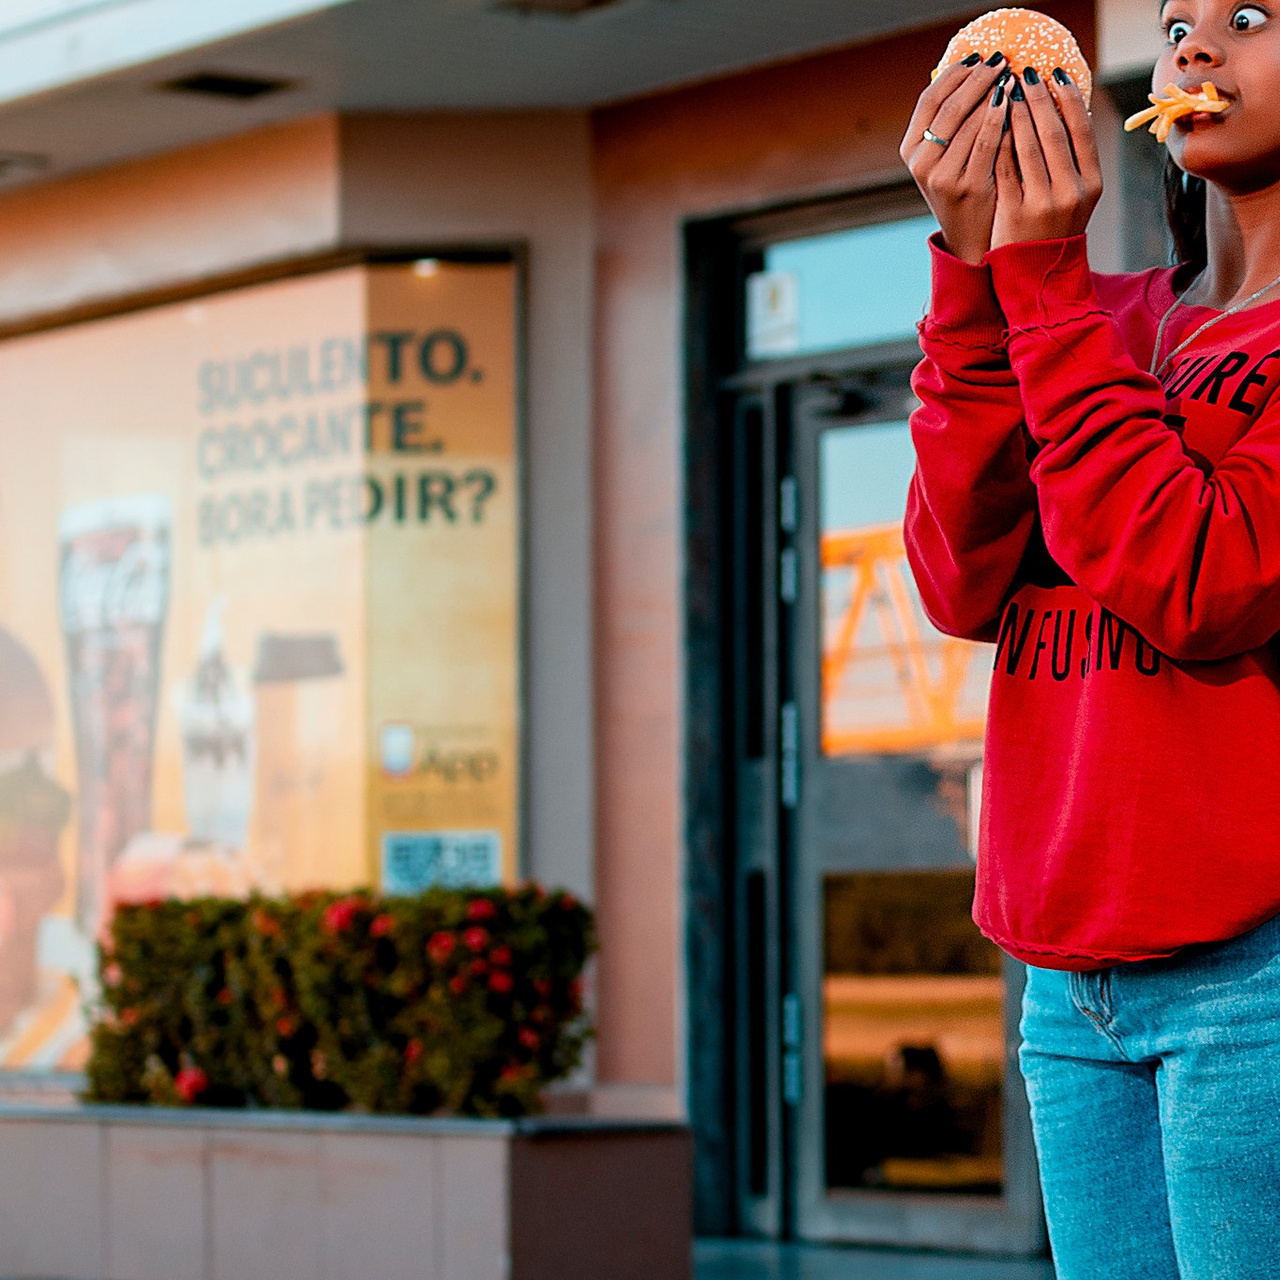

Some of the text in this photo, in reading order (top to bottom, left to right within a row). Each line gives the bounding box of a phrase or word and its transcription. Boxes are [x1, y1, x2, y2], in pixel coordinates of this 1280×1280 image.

[199, 328, 483, 415] SUCULENTO.
[199, 400, 443, 482] CROCANTE.
[304, 468, 497, 531] PEDIR?
